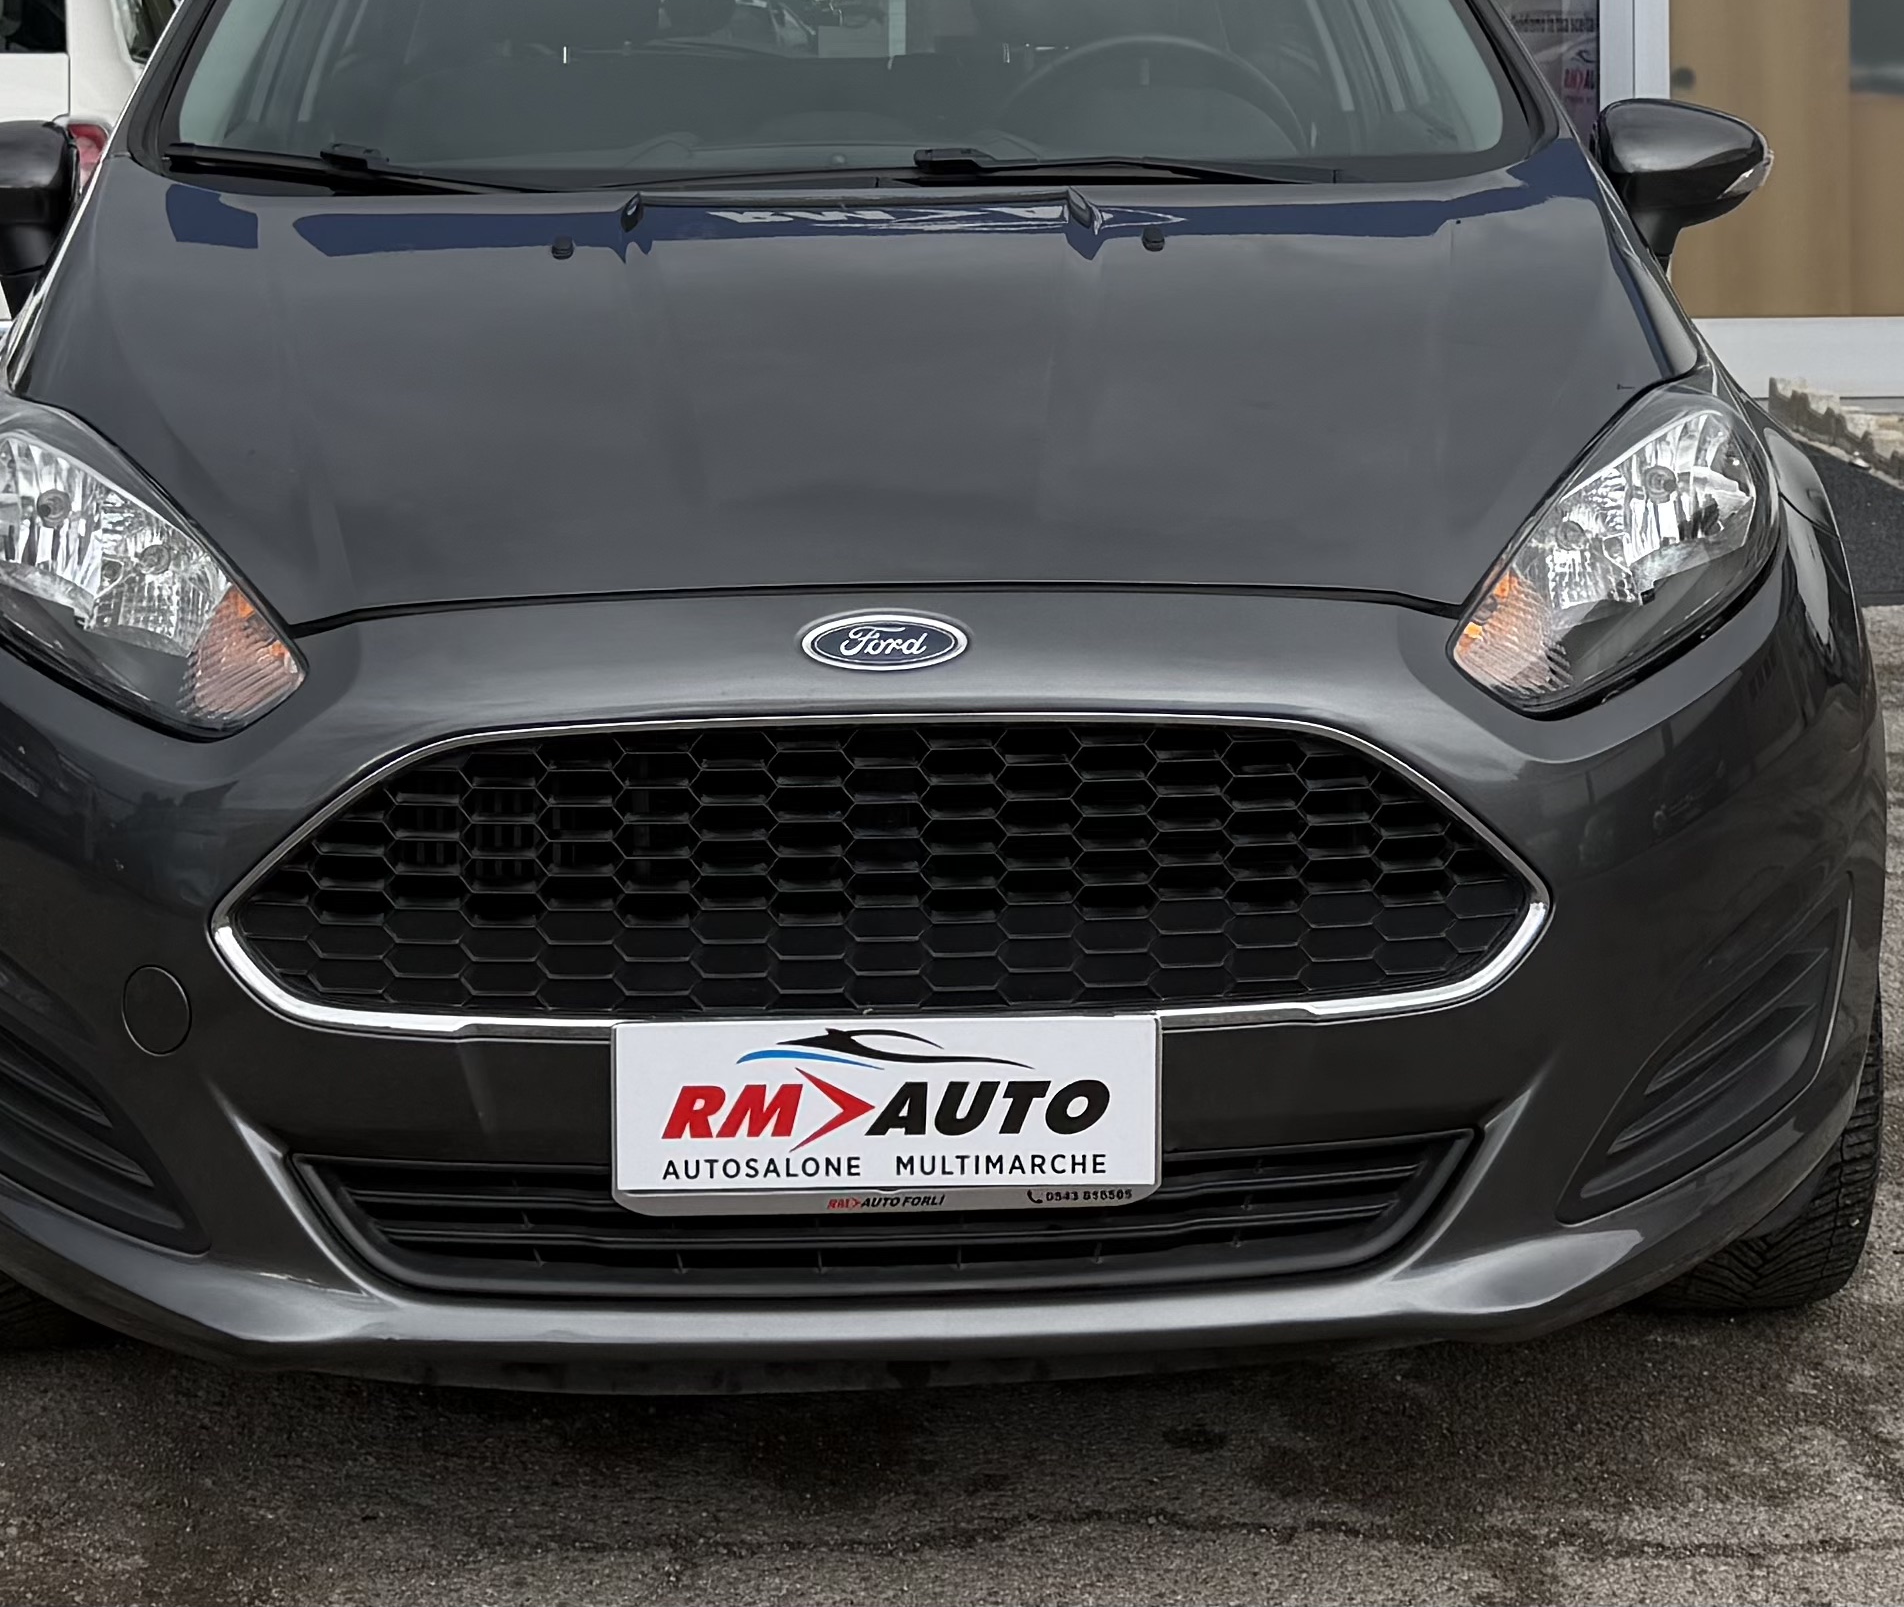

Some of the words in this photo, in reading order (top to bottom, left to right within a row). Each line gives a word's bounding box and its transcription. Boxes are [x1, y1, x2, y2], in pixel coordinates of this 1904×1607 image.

[839, 625, 928, 656] Ford
[864, 1080, 1110, 1137] AUTO
[662, 1156, 862, 1181] AUTOSALONE
[895, 1153, 1107, 1176] MULTIMARCHE
